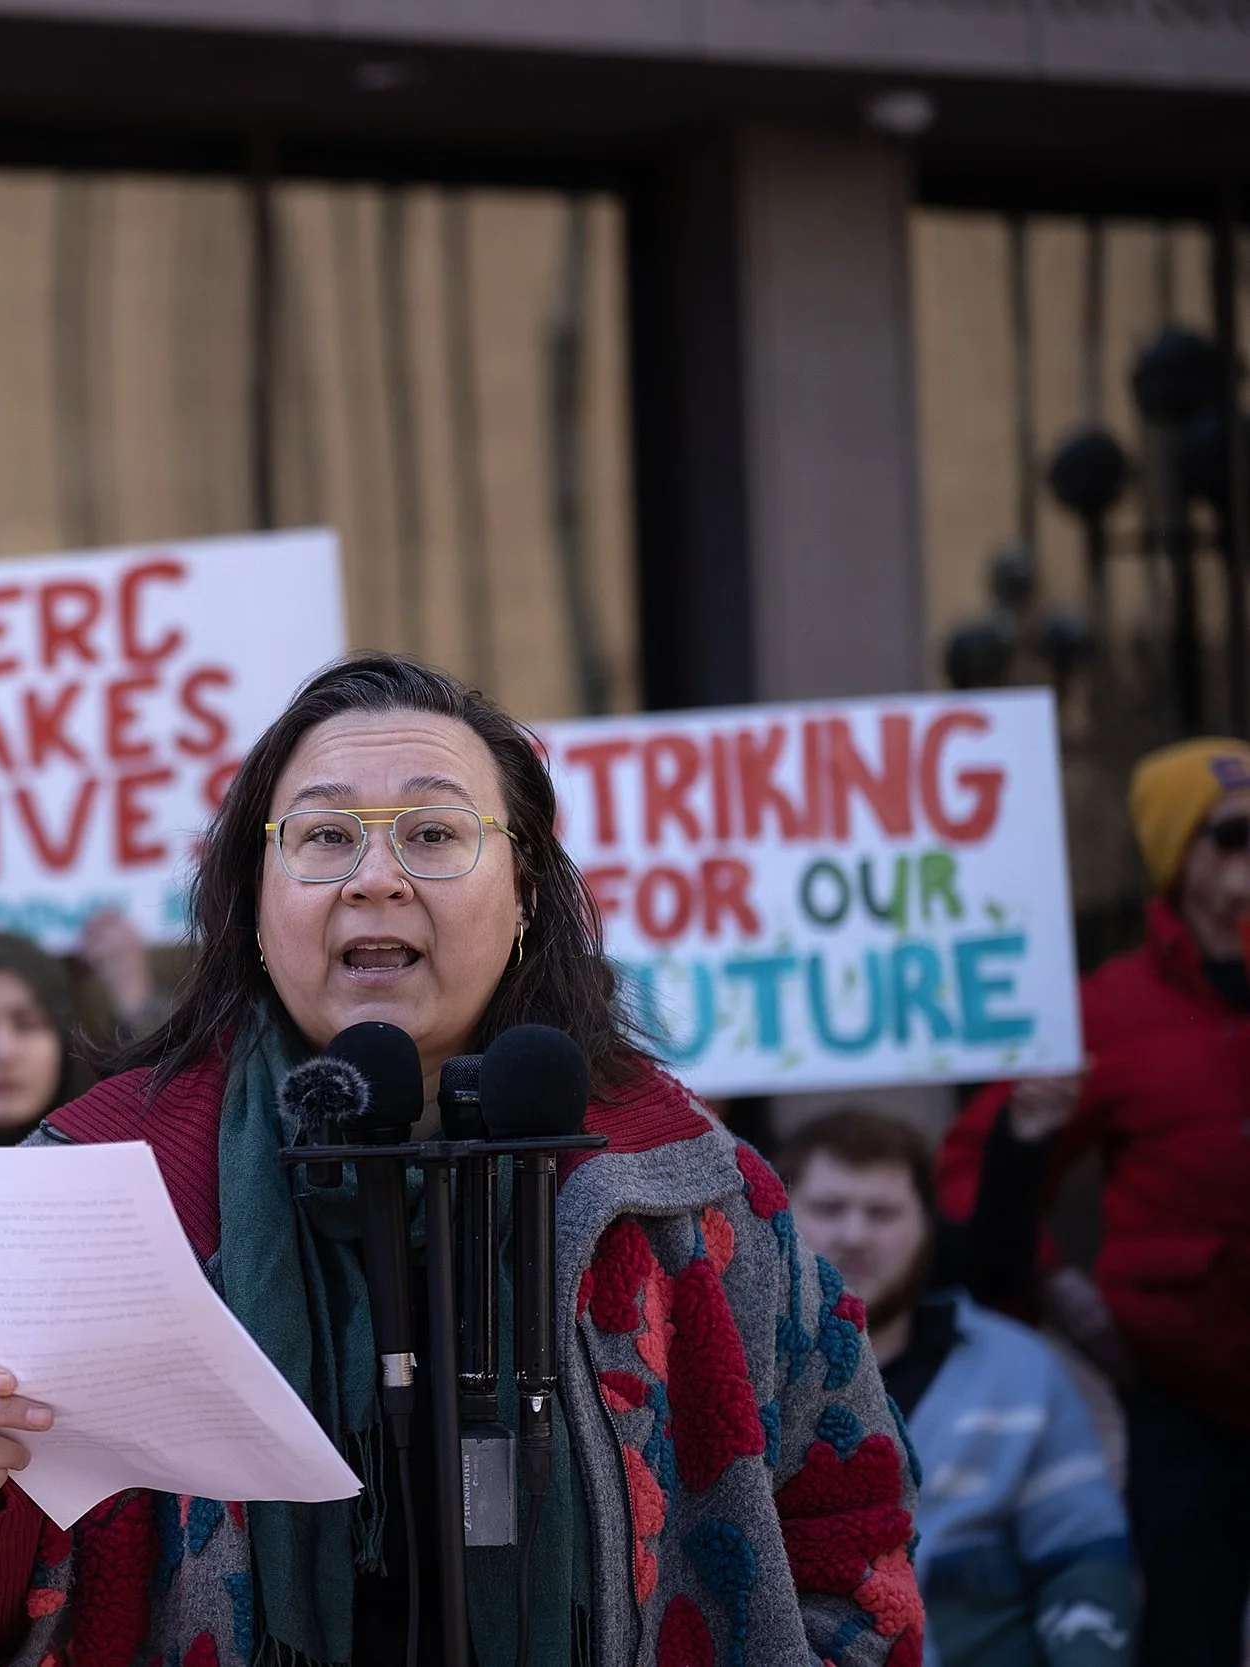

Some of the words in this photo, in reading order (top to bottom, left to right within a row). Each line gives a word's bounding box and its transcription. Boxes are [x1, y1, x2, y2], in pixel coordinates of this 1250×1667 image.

[534, 707, 1007, 848] TRIKING
[797, 850, 964, 932] OUR
[622, 931, 1035, 1068] UTURE
